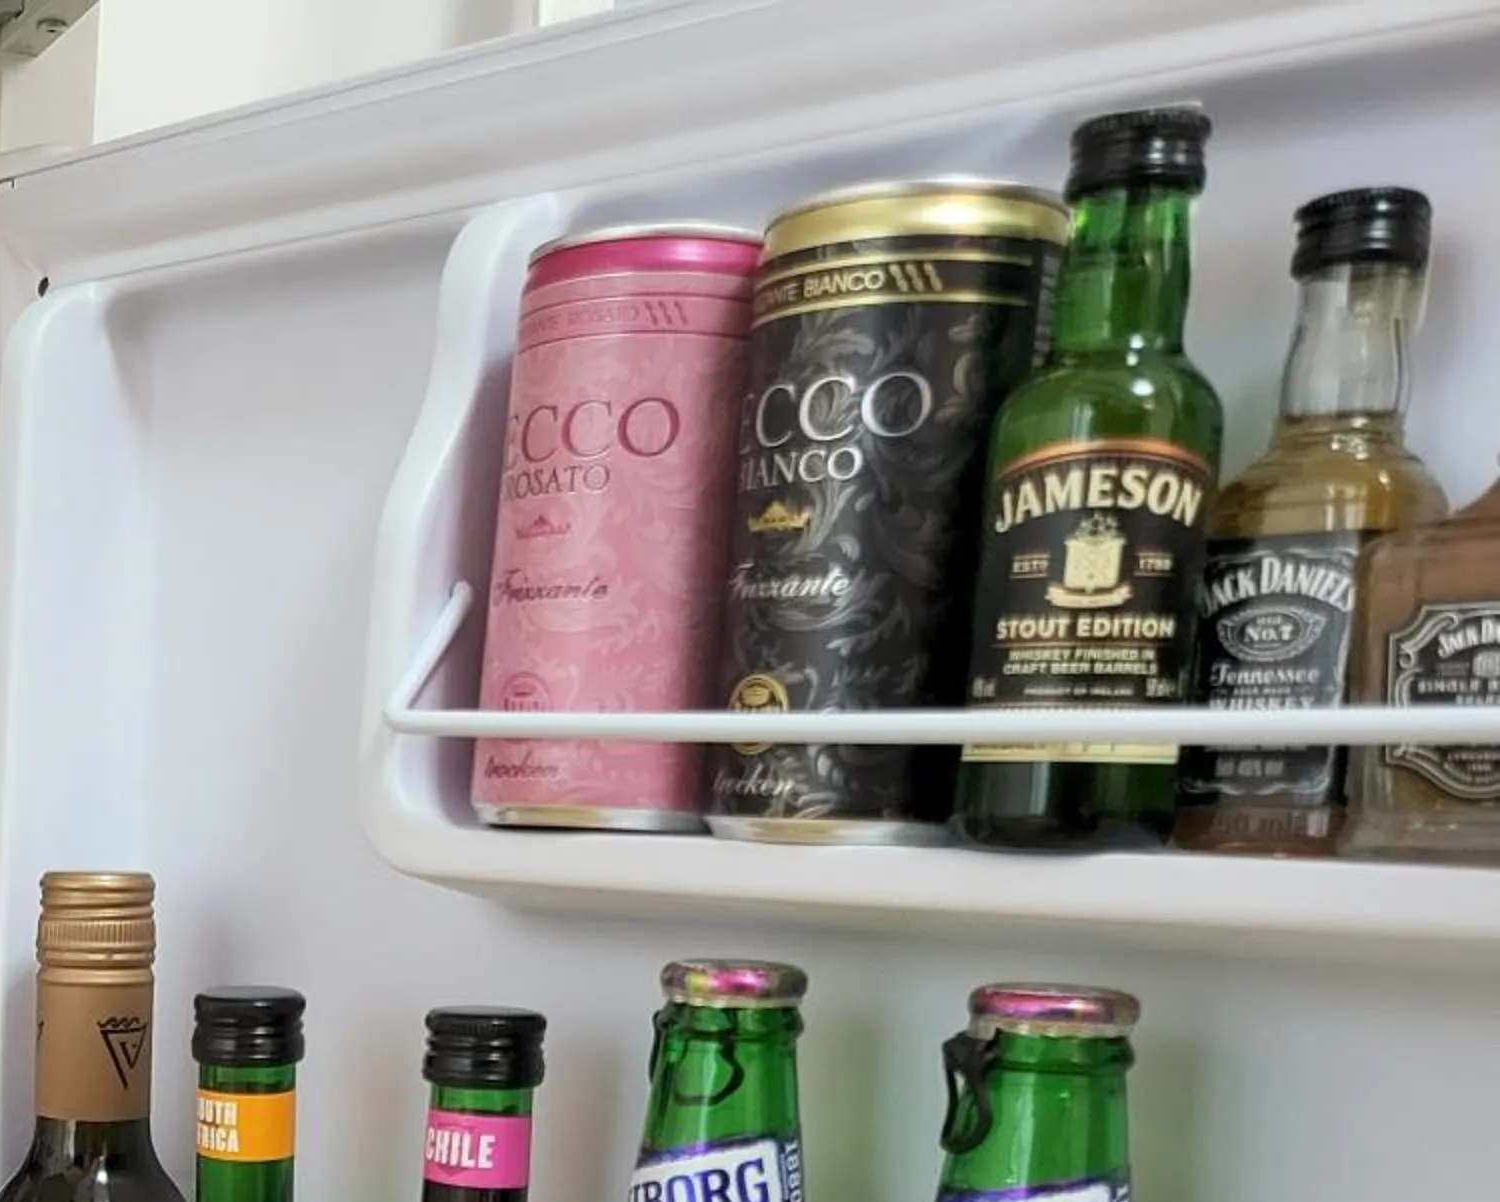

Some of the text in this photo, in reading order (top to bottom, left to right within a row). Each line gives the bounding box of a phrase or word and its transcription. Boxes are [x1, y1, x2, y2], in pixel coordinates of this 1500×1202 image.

[803, 270, 885, 298] BIANCO
[510, 397, 680, 464] CCO
[742, 371, 932, 450] CCO
[739, 446, 863, 491] IANCO
[995, 467, 1203, 533] JAMESON
[996, 615, 1176, 641] STOUT EDITION
[197, 1097, 238, 1126] OUTH
[197, 1122, 239, 1153] FRICA
[425, 1126, 496, 1170] CHILE
